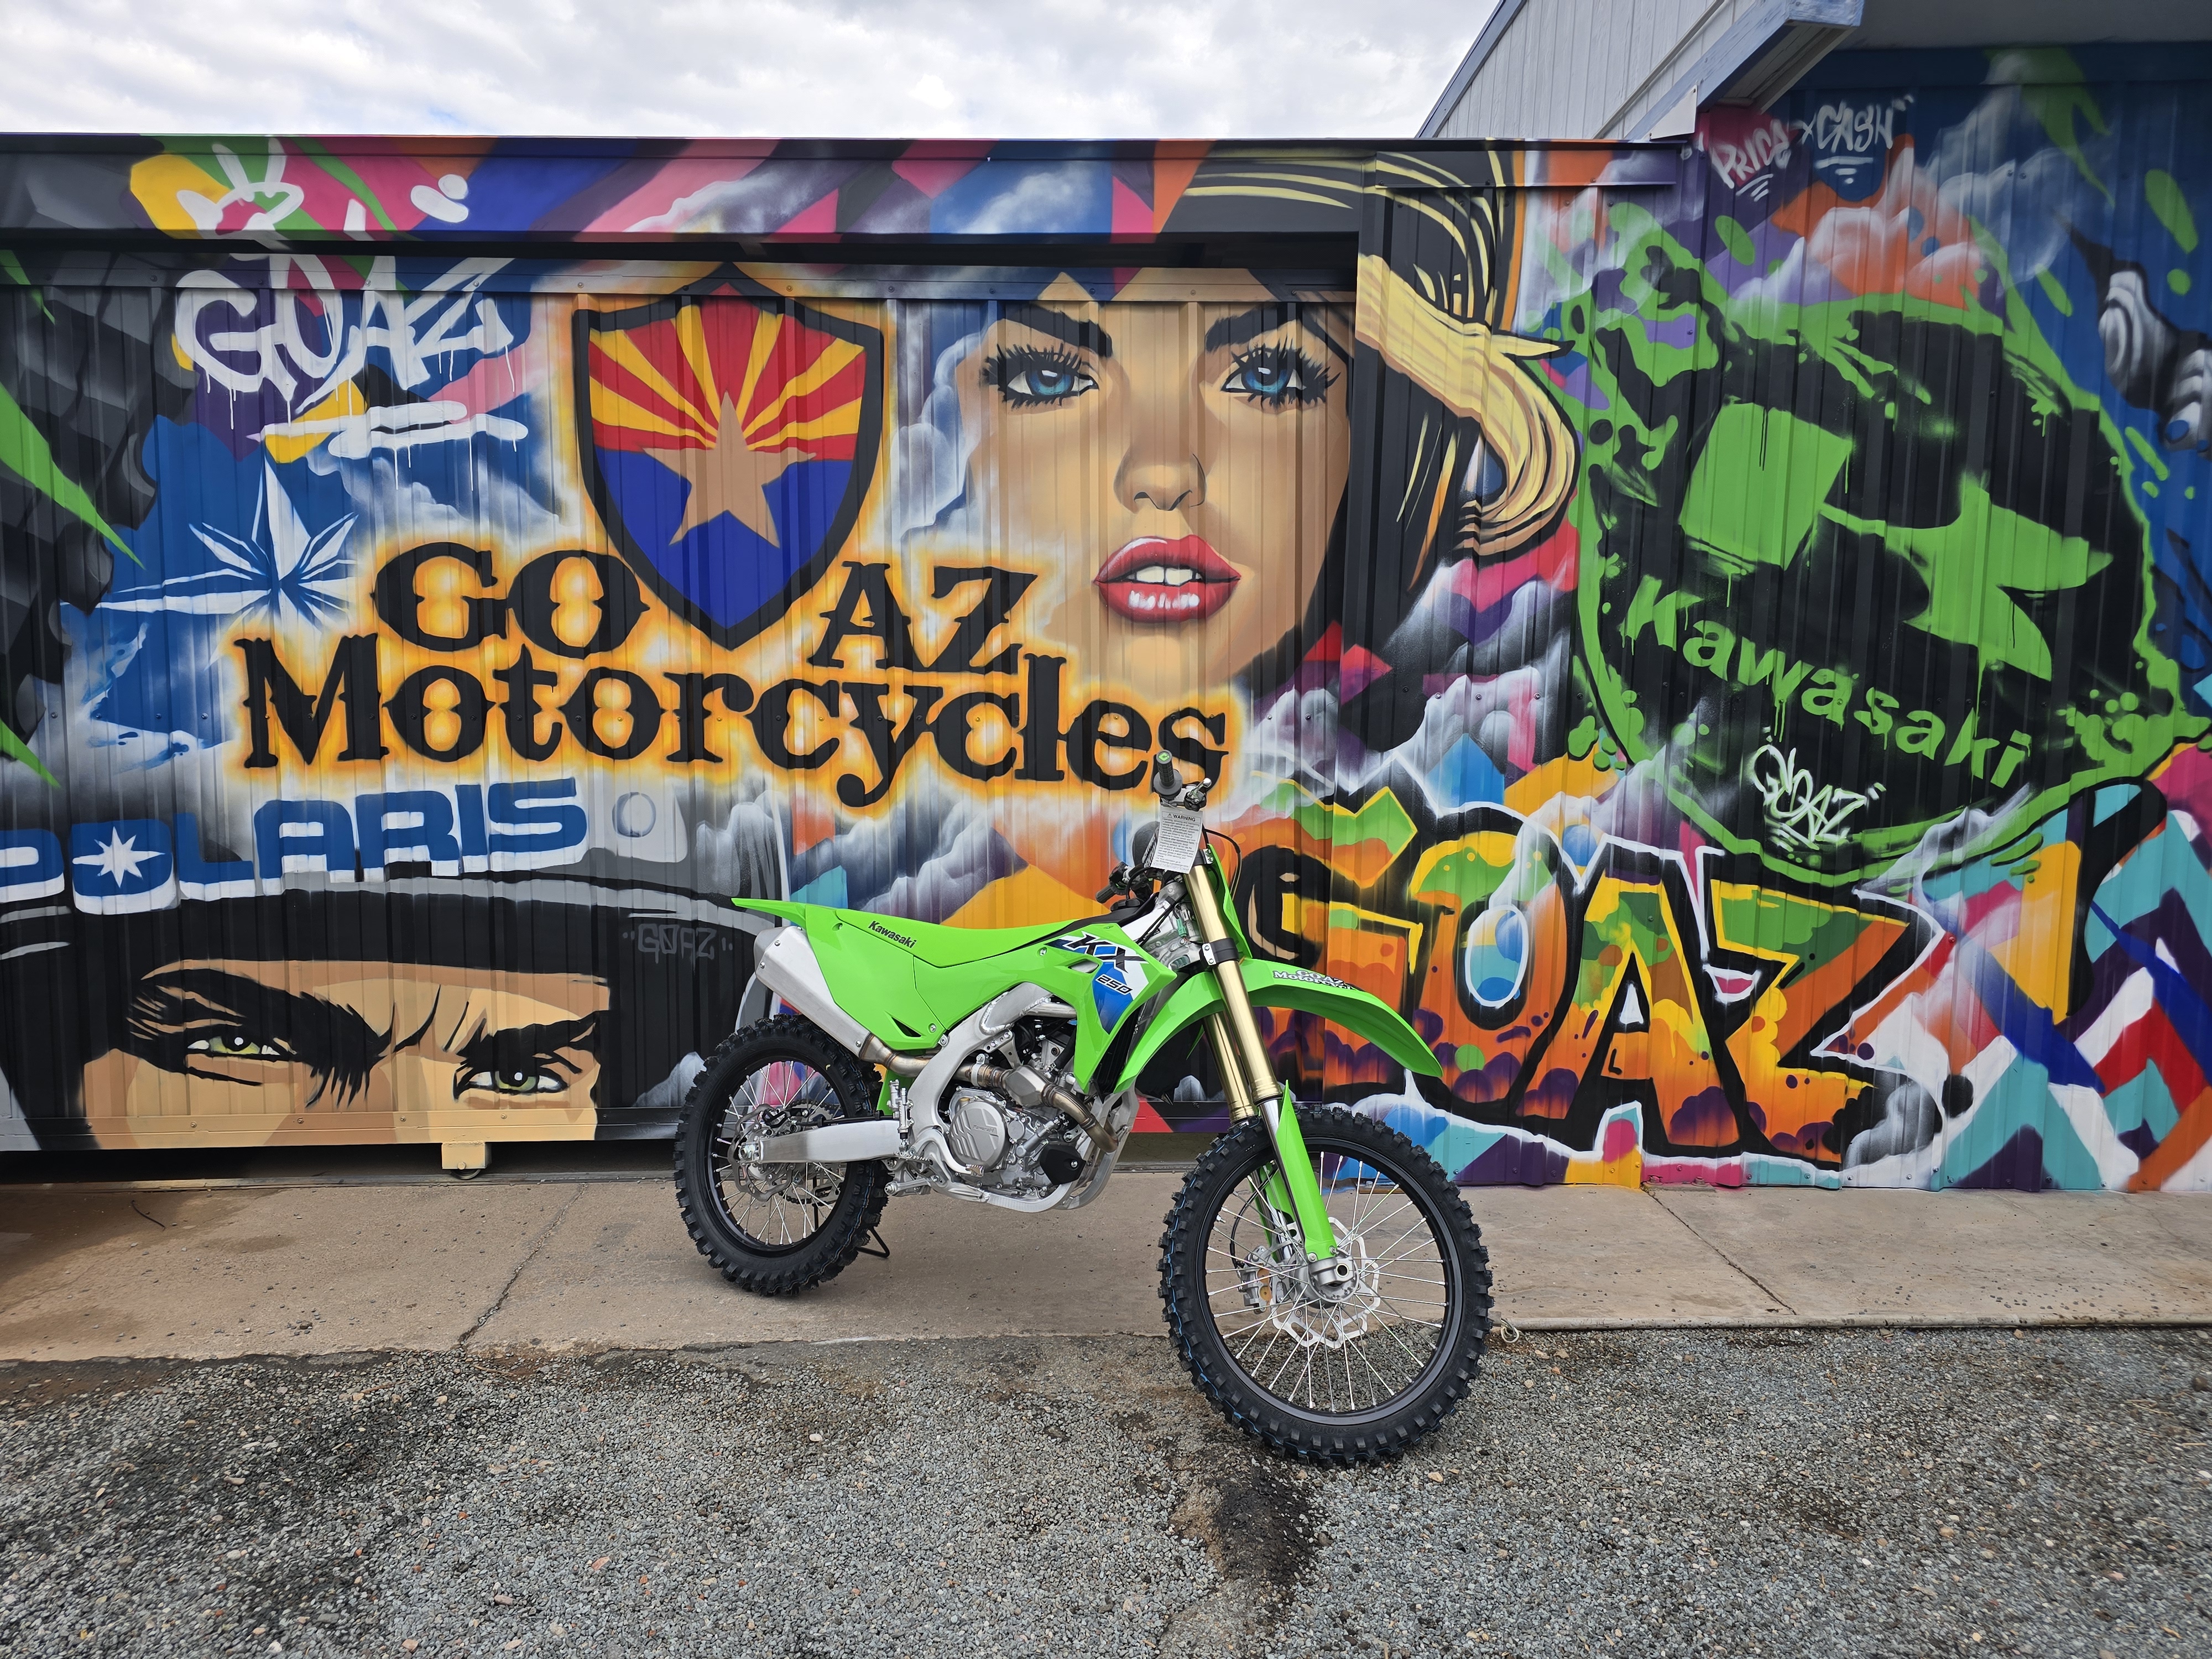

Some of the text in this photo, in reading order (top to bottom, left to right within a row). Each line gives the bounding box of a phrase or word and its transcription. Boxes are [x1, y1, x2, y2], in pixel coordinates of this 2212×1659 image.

[369, 541, 1038, 675] GO AZ
[1618, 574, 2032, 788] Kawasaki
[234, 633, 1229, 808] Motorcycles
[868, 920, 917, 948] Kawasaki
[1063, 931, 1149, 974] KX
[1096, 974, 1133, 995] 250
[1273, 971, 1353, 990] Motorcycl
